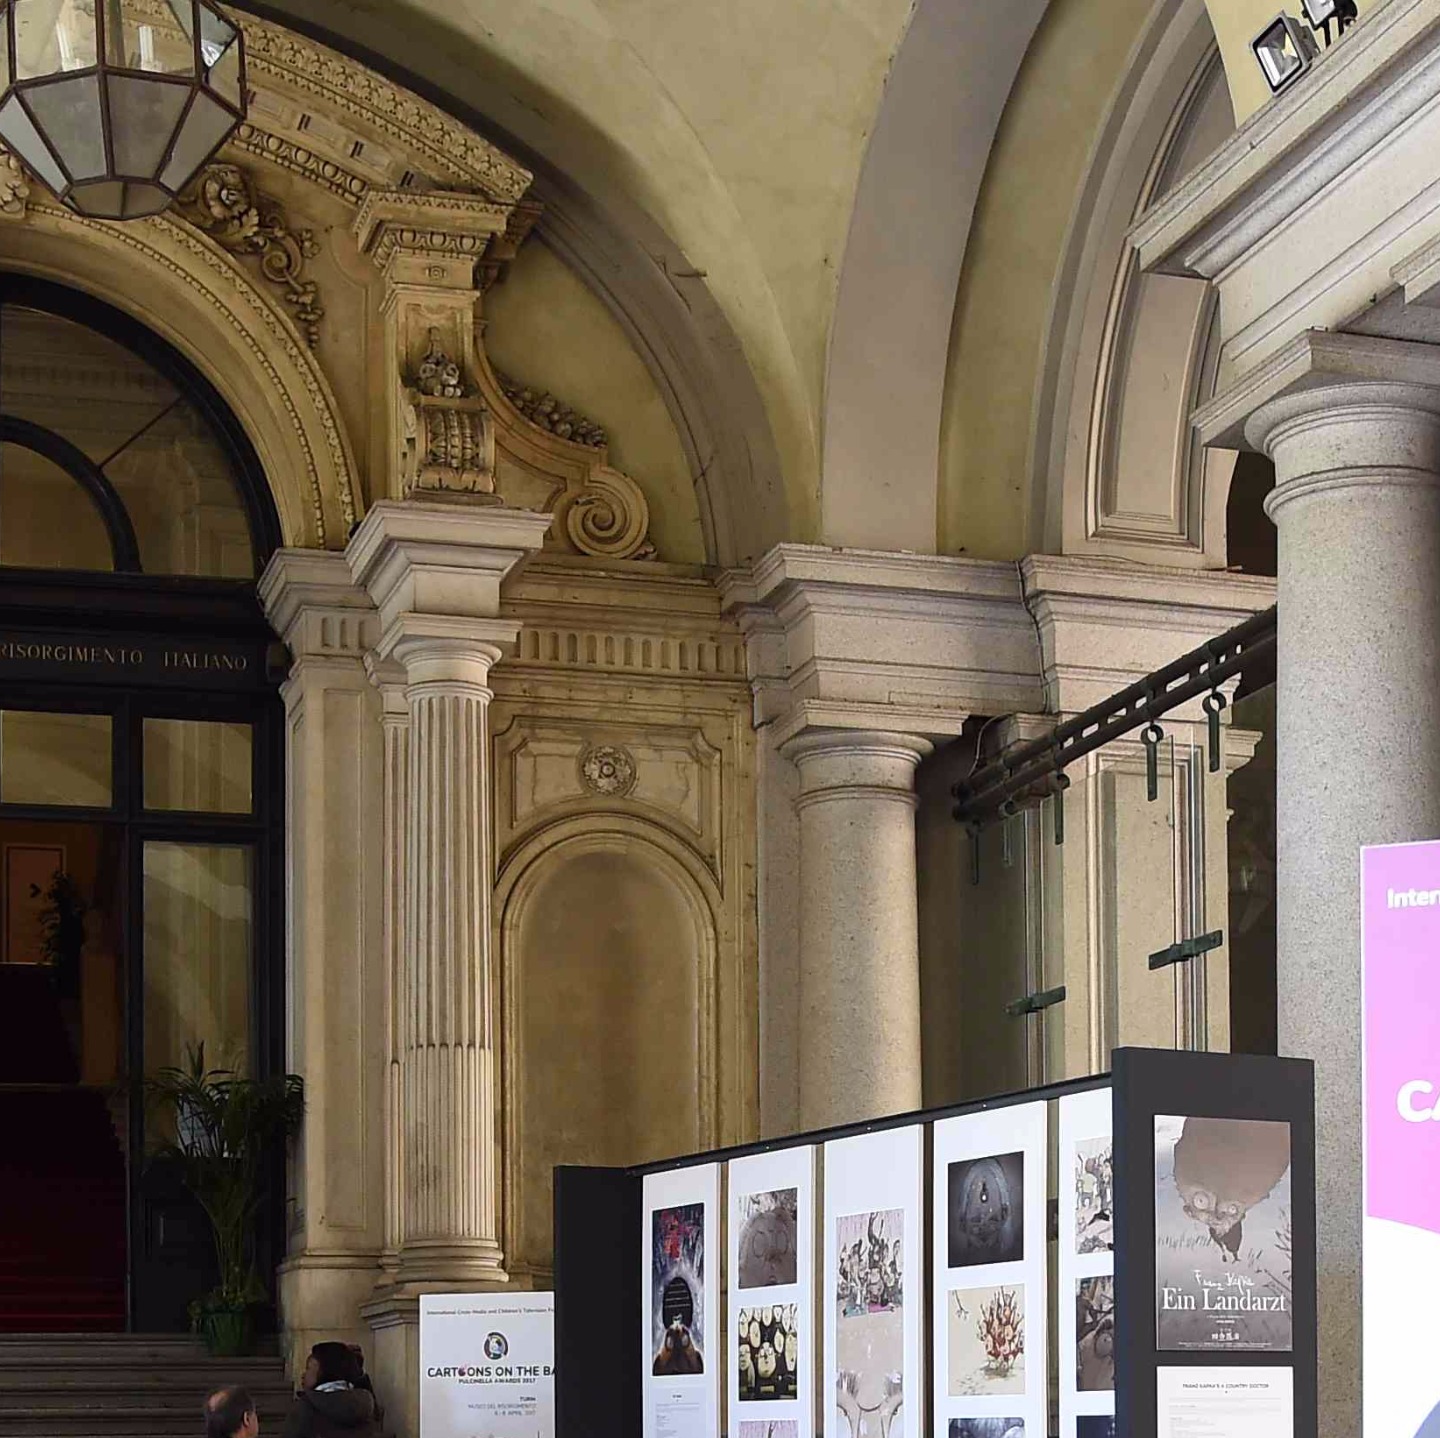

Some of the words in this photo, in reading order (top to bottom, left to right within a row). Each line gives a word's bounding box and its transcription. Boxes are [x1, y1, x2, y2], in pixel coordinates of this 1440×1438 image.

[164, 651, 247, 671] ITALIANO
[1161, 1287, 1197, 1310] Ein
[1202, 1288, 1288, 1311] Landarzt
[427, 1366, 492, 1377] CARTOONS
[495, 1366, 513, 1377] ON
[516, 1366, 540, 1377] THE
[543, 1366, 557, 1376] BA
